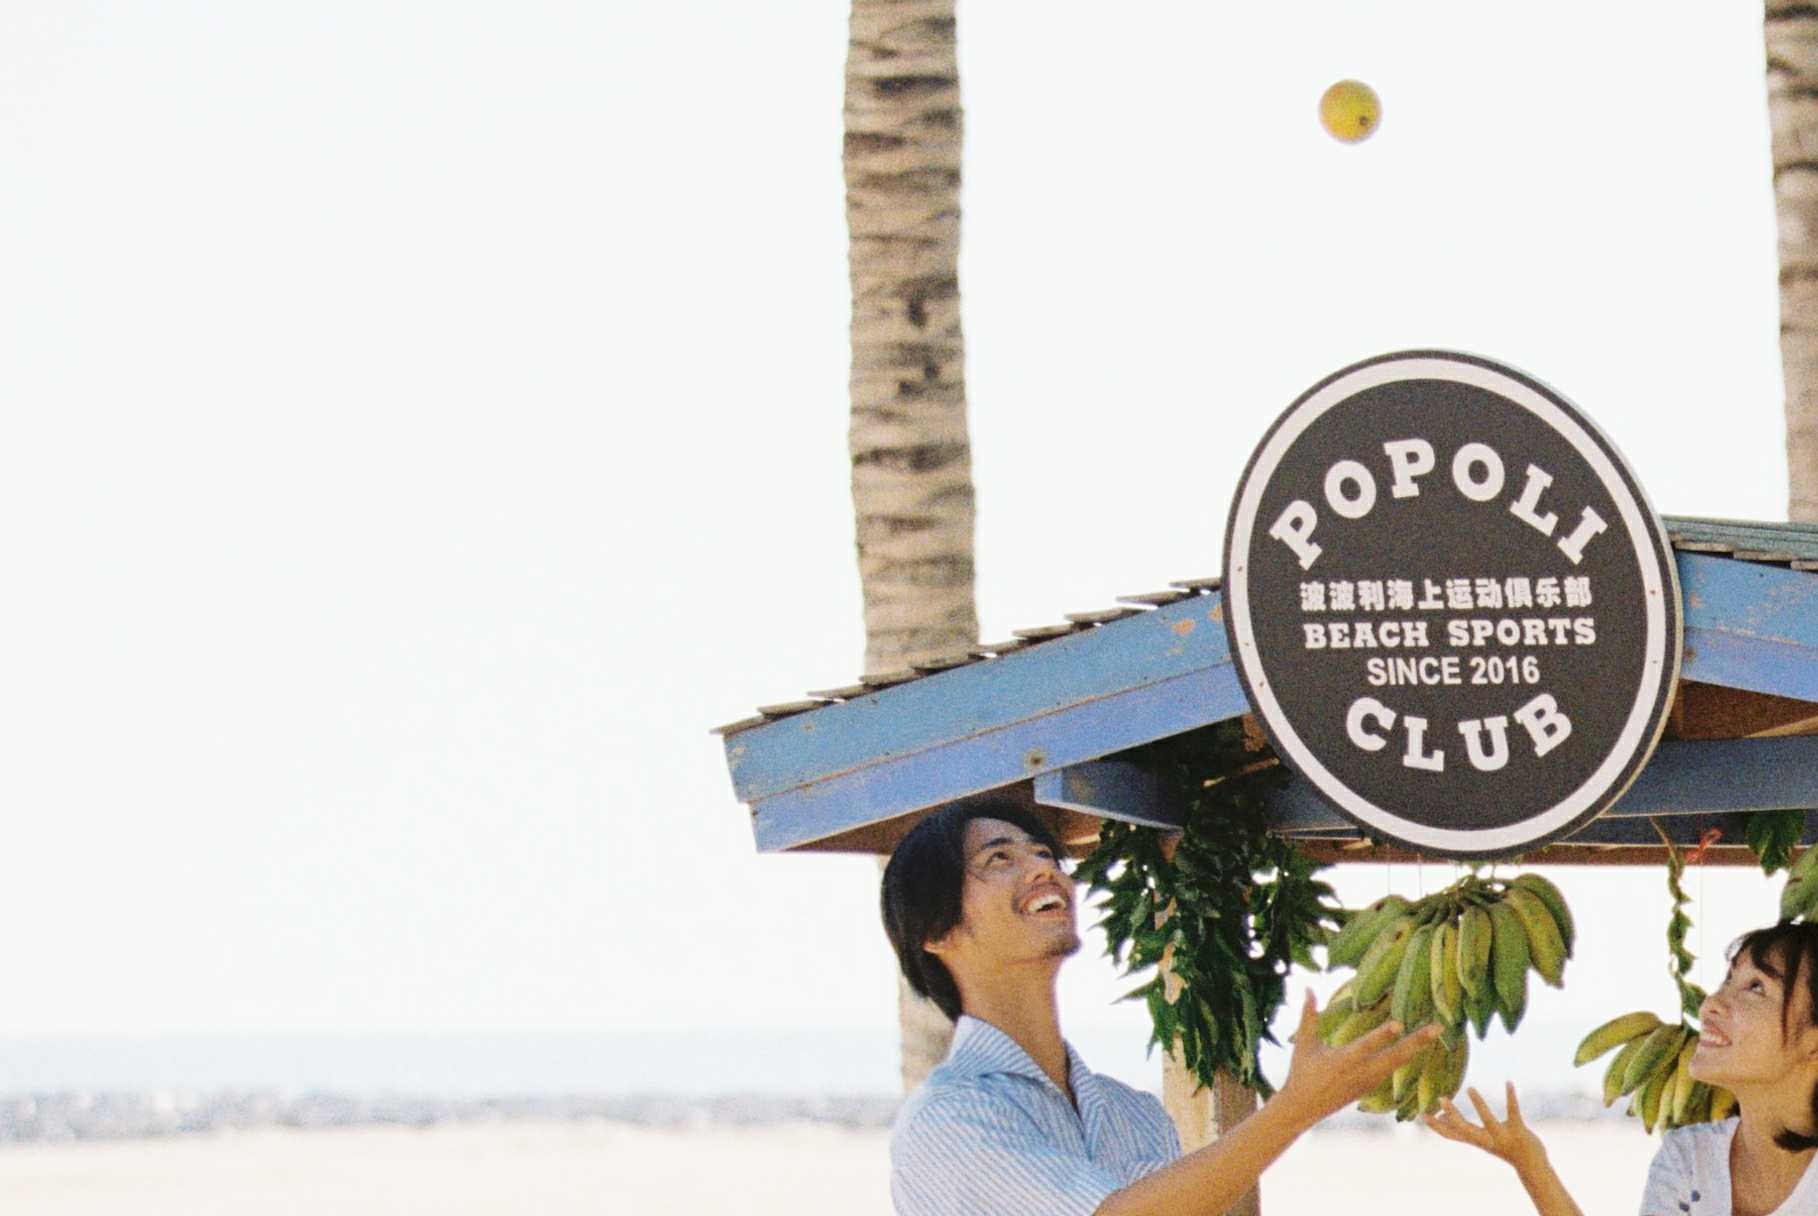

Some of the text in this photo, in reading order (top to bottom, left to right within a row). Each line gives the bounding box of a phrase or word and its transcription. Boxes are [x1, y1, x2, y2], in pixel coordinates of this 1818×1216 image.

[1269, 437, 1608, 570] POPOLI
[1299, 576, 1593, 612] 波波利海上运动俱乐部
[1303, 618, 1597, 649] BEACH SPORTS
[1366, 655, 1541, 687] SINCE 2016
[1345, 692, 1574, 773] CLUB
